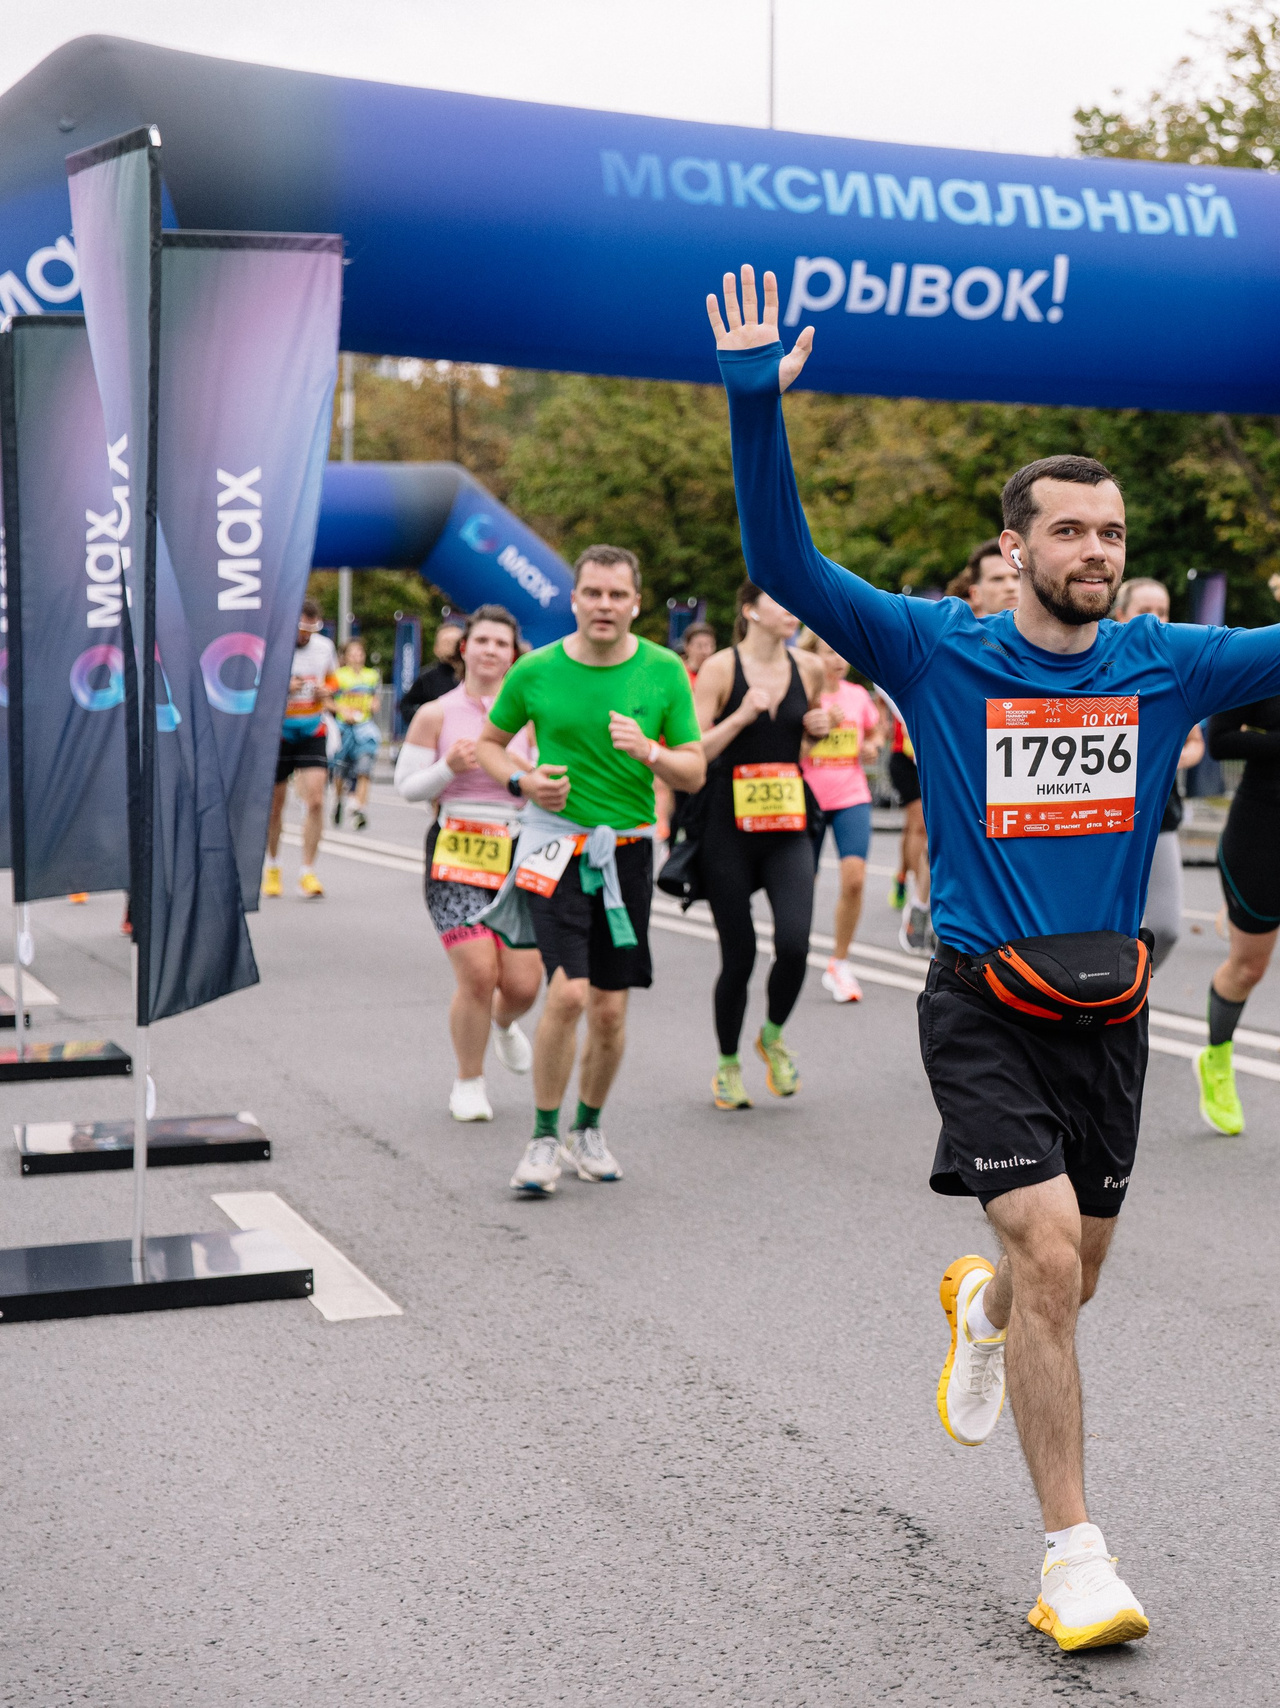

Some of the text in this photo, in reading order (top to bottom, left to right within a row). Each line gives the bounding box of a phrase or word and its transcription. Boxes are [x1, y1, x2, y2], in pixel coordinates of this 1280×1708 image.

[602, 150, 1239, 238] максимальный
[784, 254, 1069, 326] рывок!
[1081, 714, 1098, 727] 10
[995, 733, 1132, 778] 17956
[1036, 783, 1091, 796] НИКИТА
[1002, 810, 1019, 835] F
[446, 834, 499, 860] 3173
